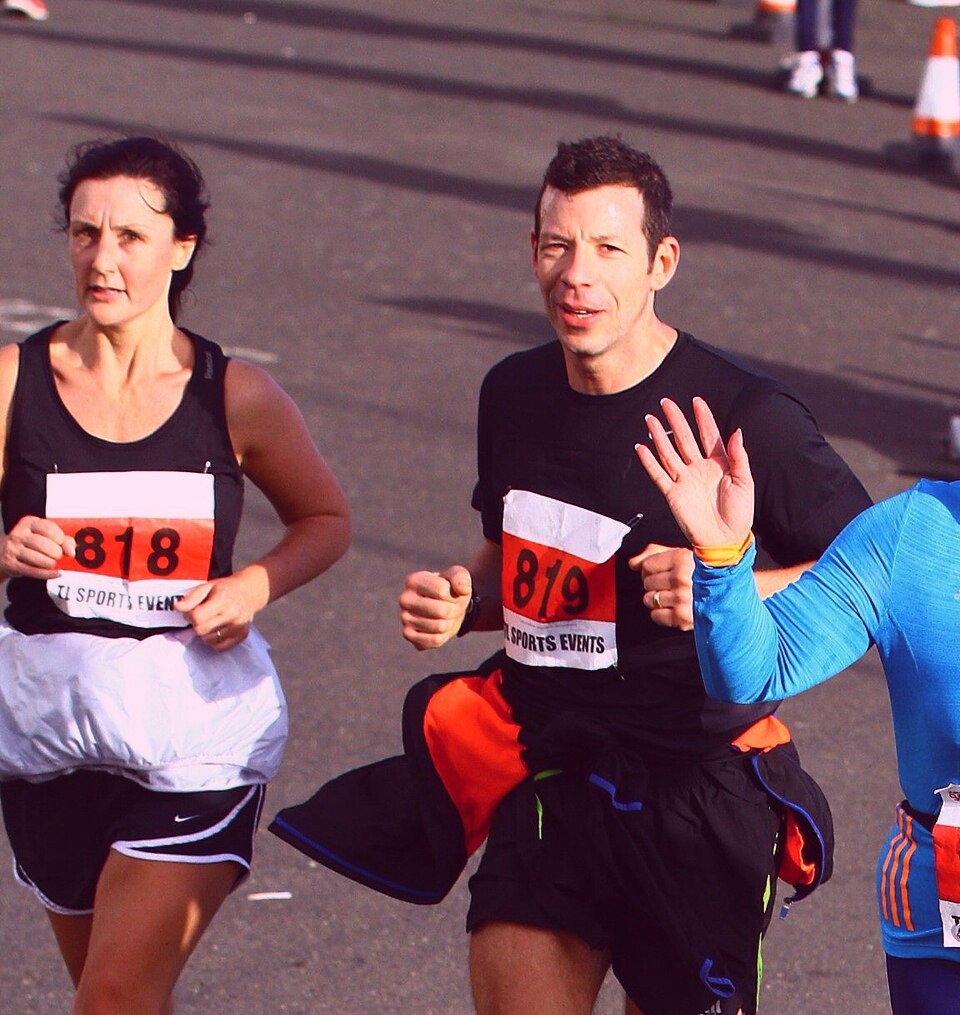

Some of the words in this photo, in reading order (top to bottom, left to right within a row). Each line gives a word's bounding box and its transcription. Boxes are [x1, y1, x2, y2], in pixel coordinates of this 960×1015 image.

[74, 526, 181, 576] 818
[57, 584, 70, 601] TL
[76, 587, 132, 610] SPORTS
[512, 548, 590, 618] 819
[511, 627, 557, 652] SPORTS
[560, 633, 605, 654] EVENTS
